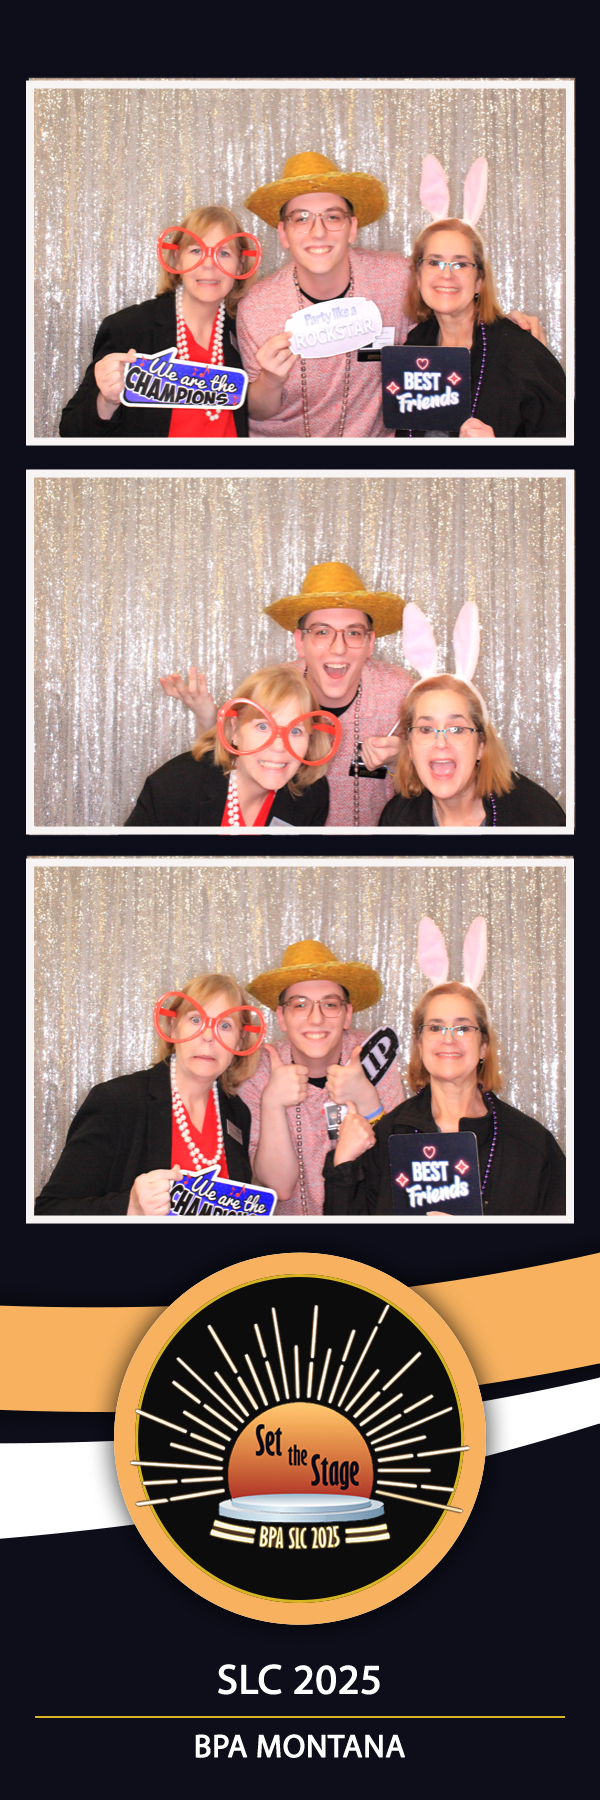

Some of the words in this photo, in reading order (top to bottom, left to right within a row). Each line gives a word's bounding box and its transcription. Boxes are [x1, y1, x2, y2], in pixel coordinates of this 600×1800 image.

[304, 312, 331, 326] Party
[332, 306, 350, 317] like
[350, 306, 357, 316] a
[294, 318, 375, 350] ROCKSTAR
[125, 366, 229, 406] CHAMPIONS
[149, 358, 178, 381] We
[180, 375, 207, 389] are
[210, 374, 237, 392] the
[403, 371, 441, 391] BEST
[396, 385, 460, 413] Friends
[361, 1036, 392, 1081] IP
[411, 1161, 449, 1181] BEST
[170, 1184, 256, 1216] CHAMP
[191, 1175, 217, 1201] We
[218, 1195, 241, 1210] are
[244, 1194, 266, 1213] the
[405, 1174, 469, 1208] Friends
